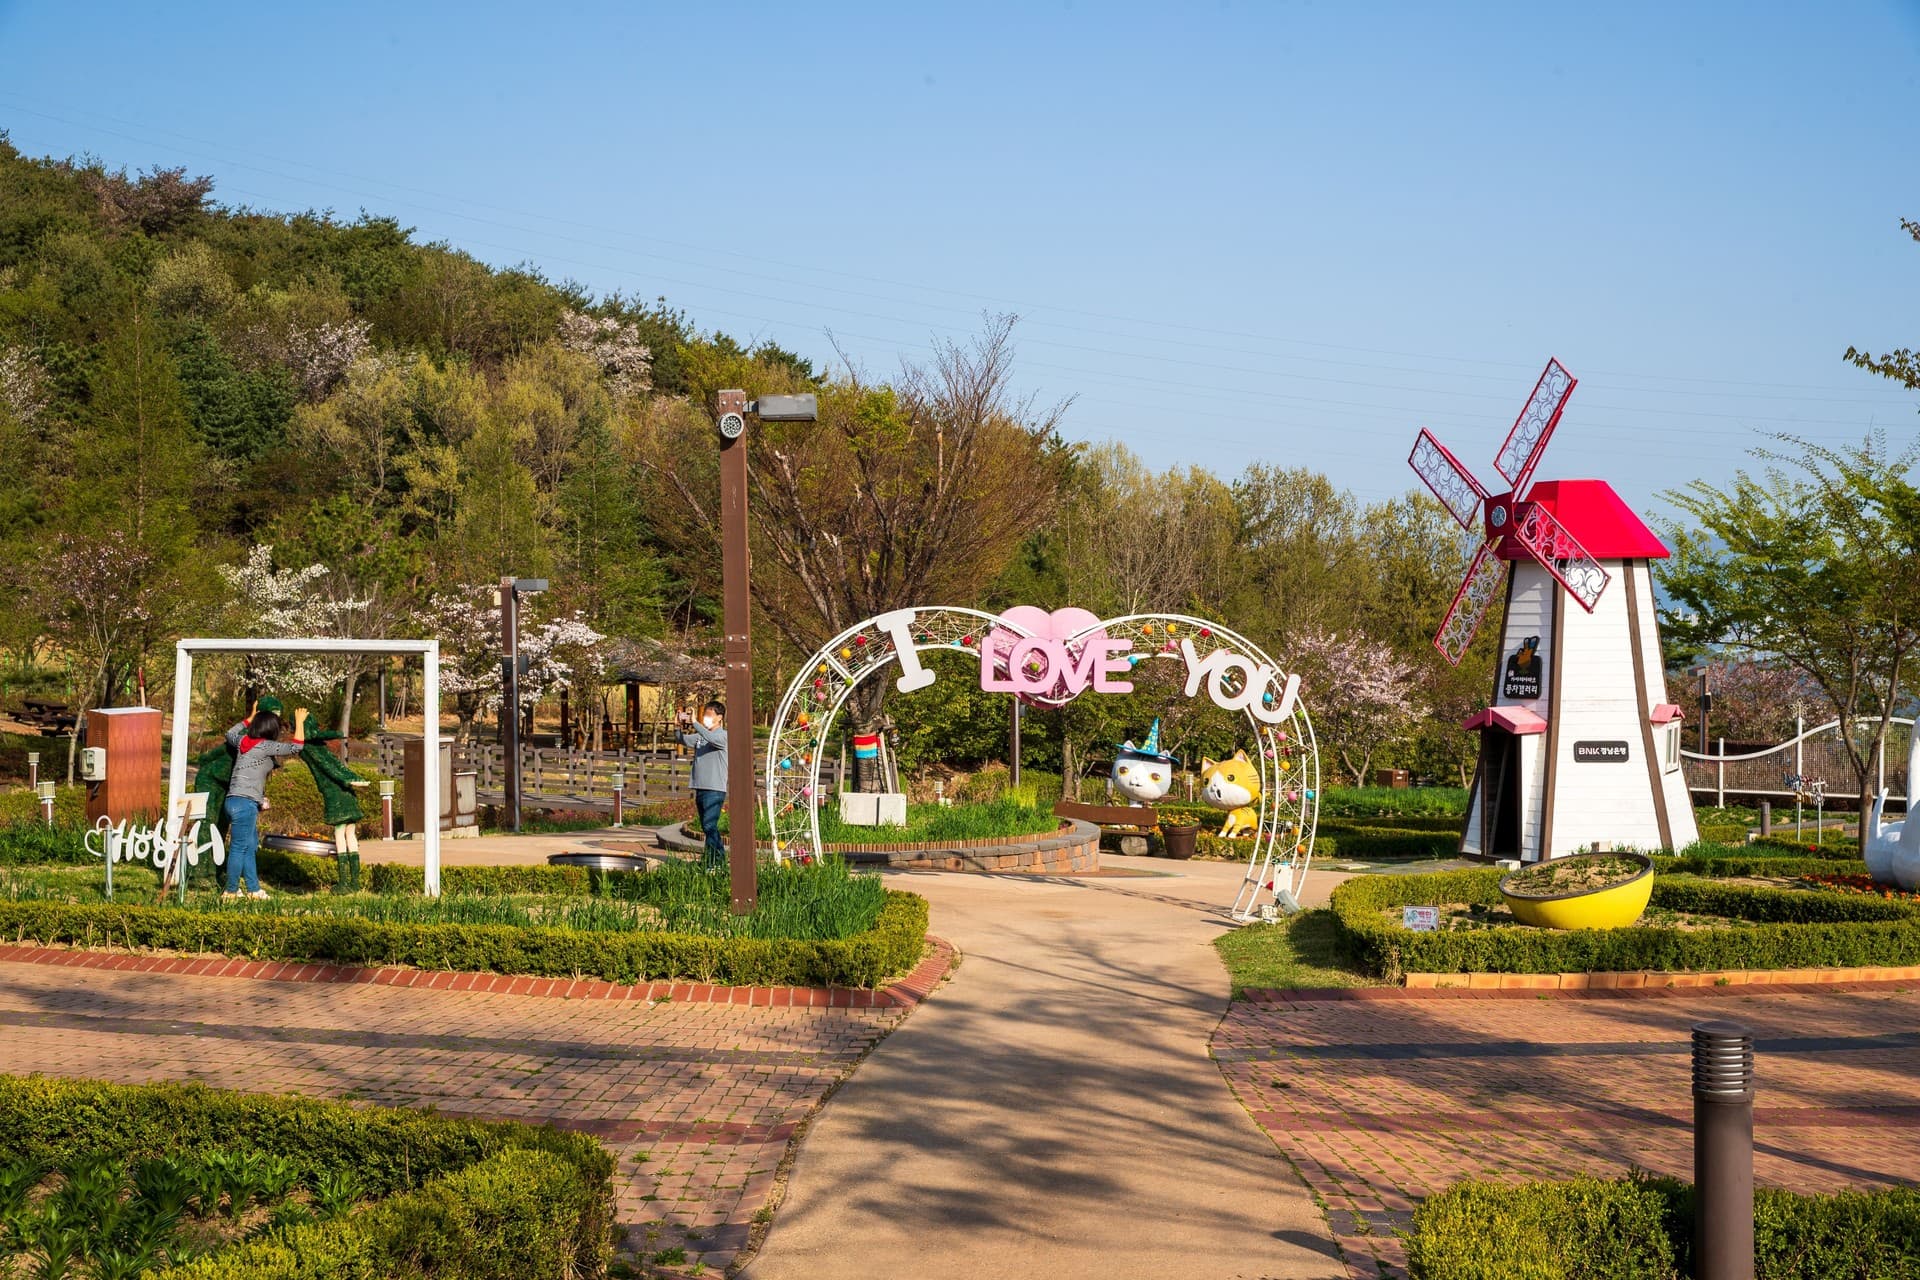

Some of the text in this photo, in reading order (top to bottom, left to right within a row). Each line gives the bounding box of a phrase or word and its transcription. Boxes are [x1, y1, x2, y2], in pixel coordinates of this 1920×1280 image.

[876, 609, 1301, 724] I LOVE YOU
[1506, 684, 1538, 695] 풍차갤러리
[1578, 747, 1627, 755] BNK 경남은행
